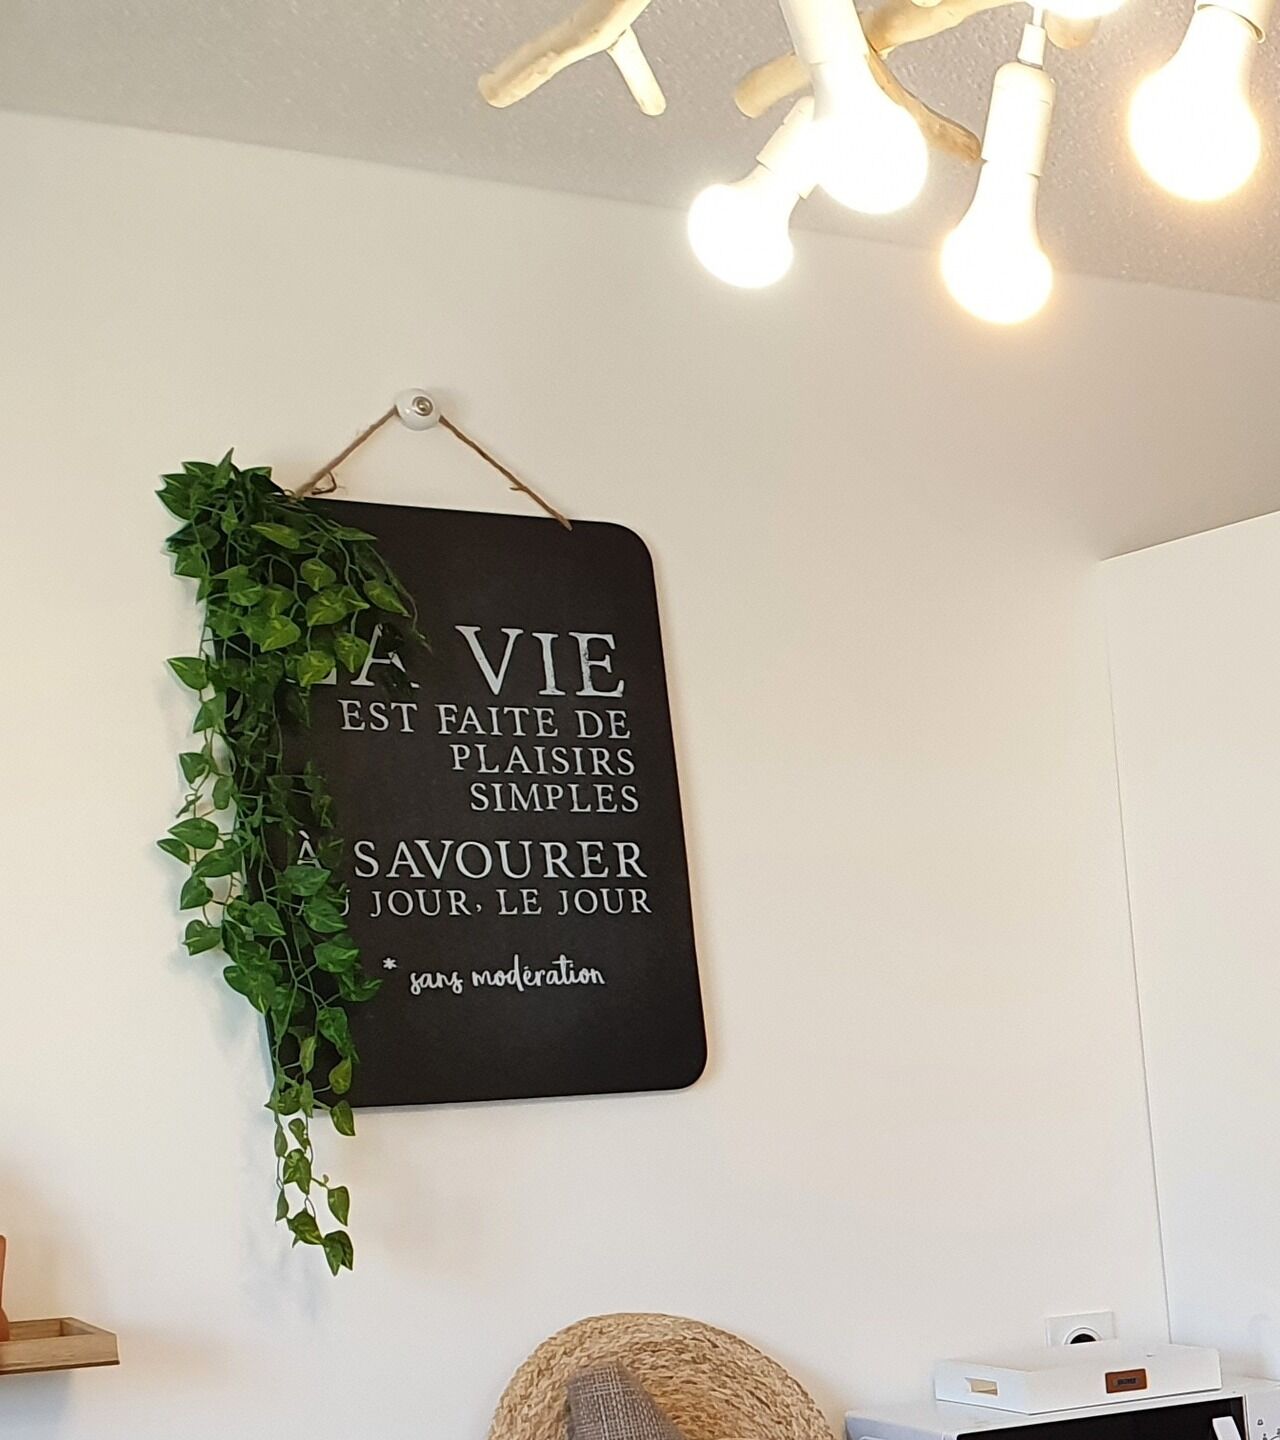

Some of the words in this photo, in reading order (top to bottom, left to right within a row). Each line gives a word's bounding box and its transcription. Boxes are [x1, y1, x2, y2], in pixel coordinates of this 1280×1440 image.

[455, 626, 625, 699] VIE
[339, 700, 417, 733] EST
[435, 704, 558, 739] FAITE
[576, 710, 631, 740] DE
[449, 744, 635, 775] PLAISIRS
[469, 782, 639, 813] SIMPLES
[354, 840, 648, 880] SAVOURER
[498, 888, 542, 915] LE
[557, 888, 652, 915] JOUR
[410, 972, 463, 995] sans
